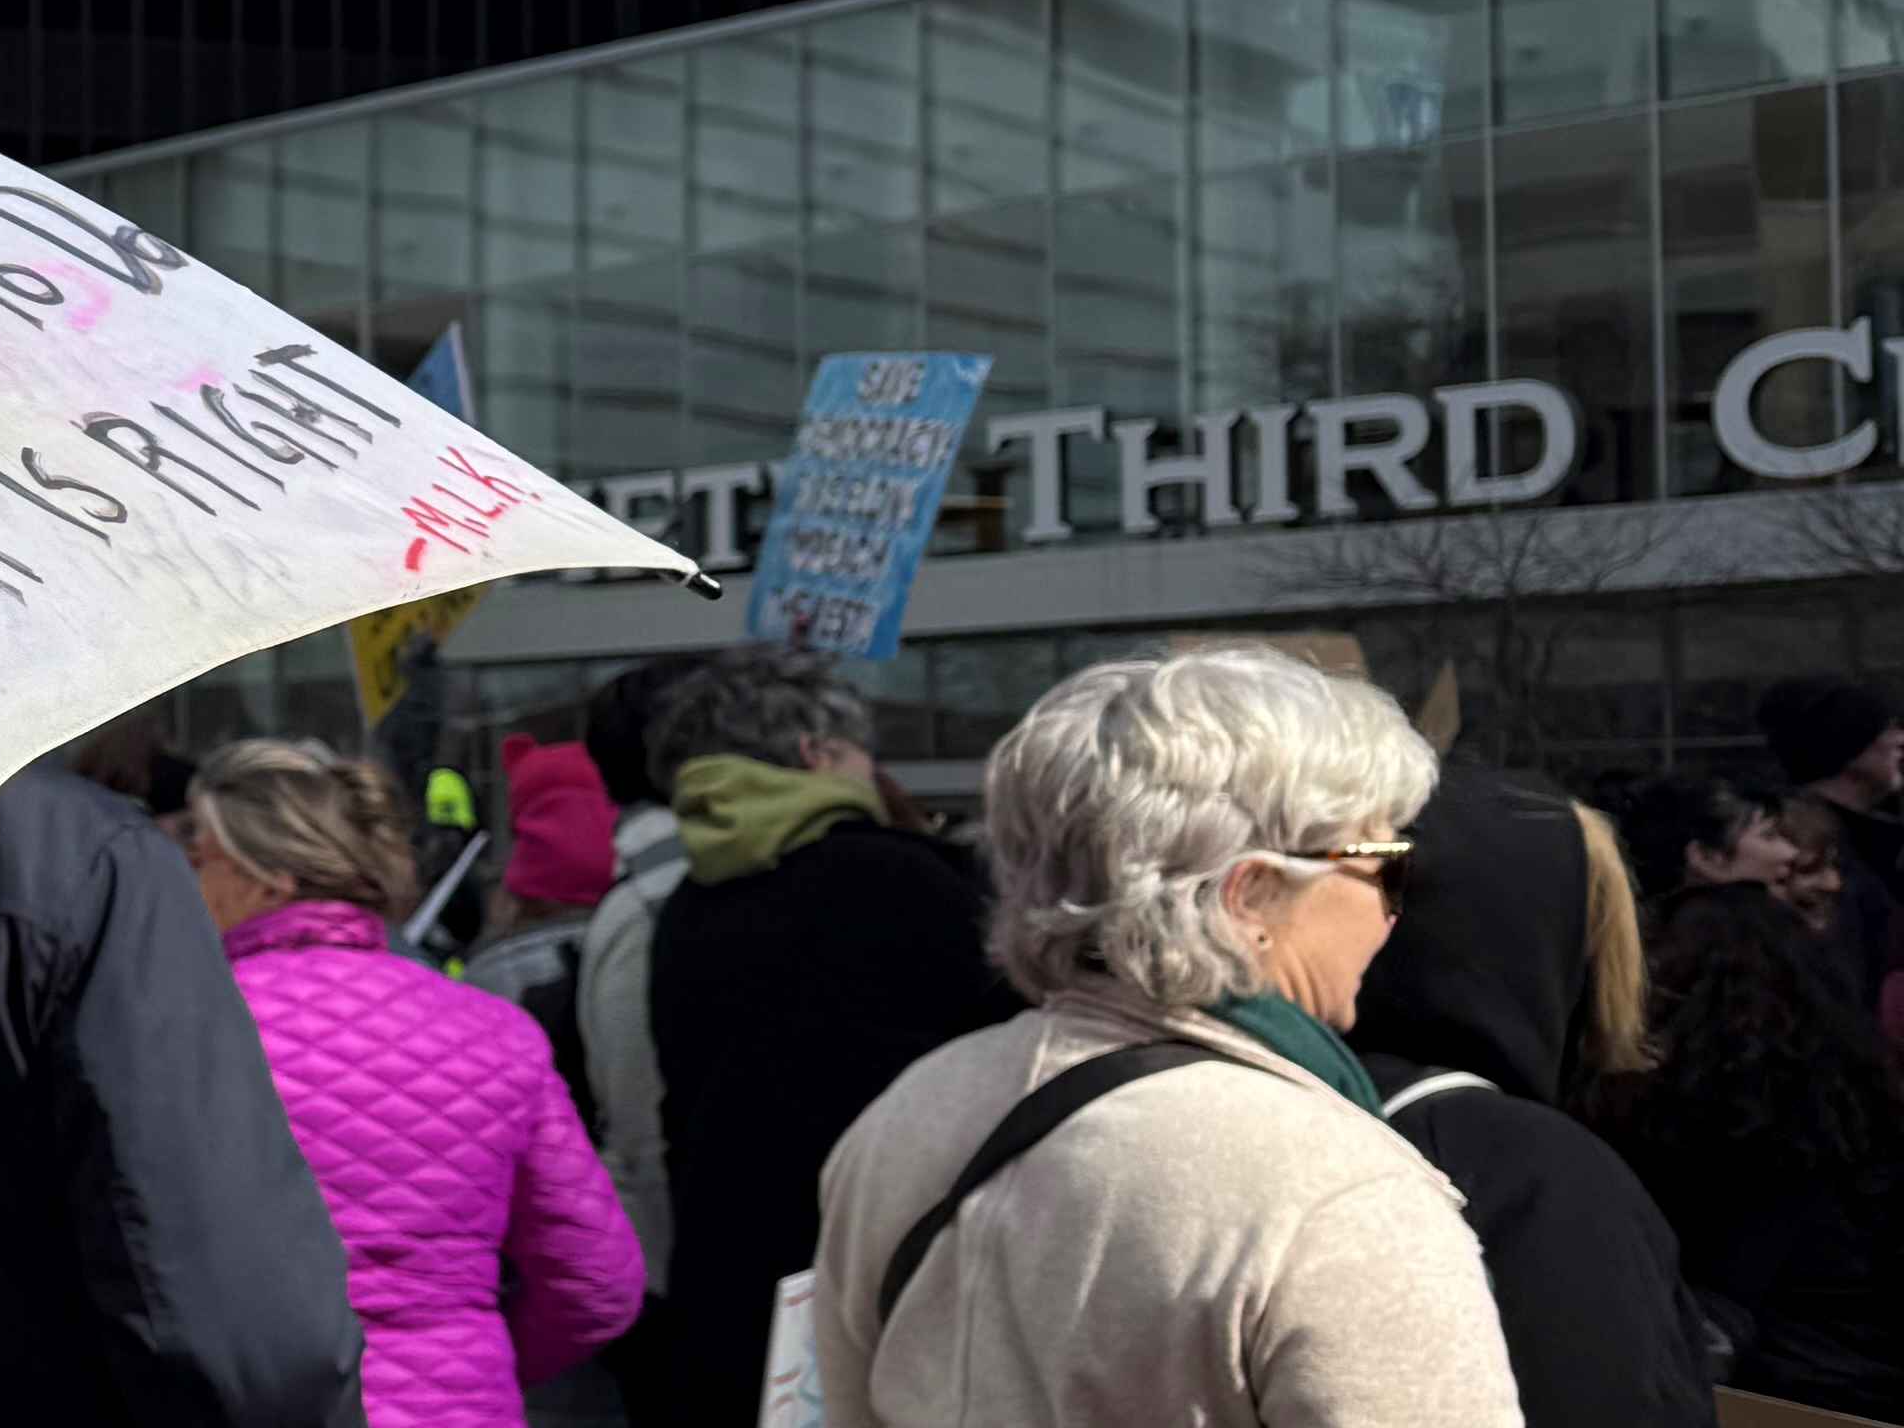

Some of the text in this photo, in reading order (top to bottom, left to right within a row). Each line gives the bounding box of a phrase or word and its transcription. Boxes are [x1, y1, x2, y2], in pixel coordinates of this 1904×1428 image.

[80, 342, 403, 517] RIGHT
[989, 316, 1904, 543] THIRD C
